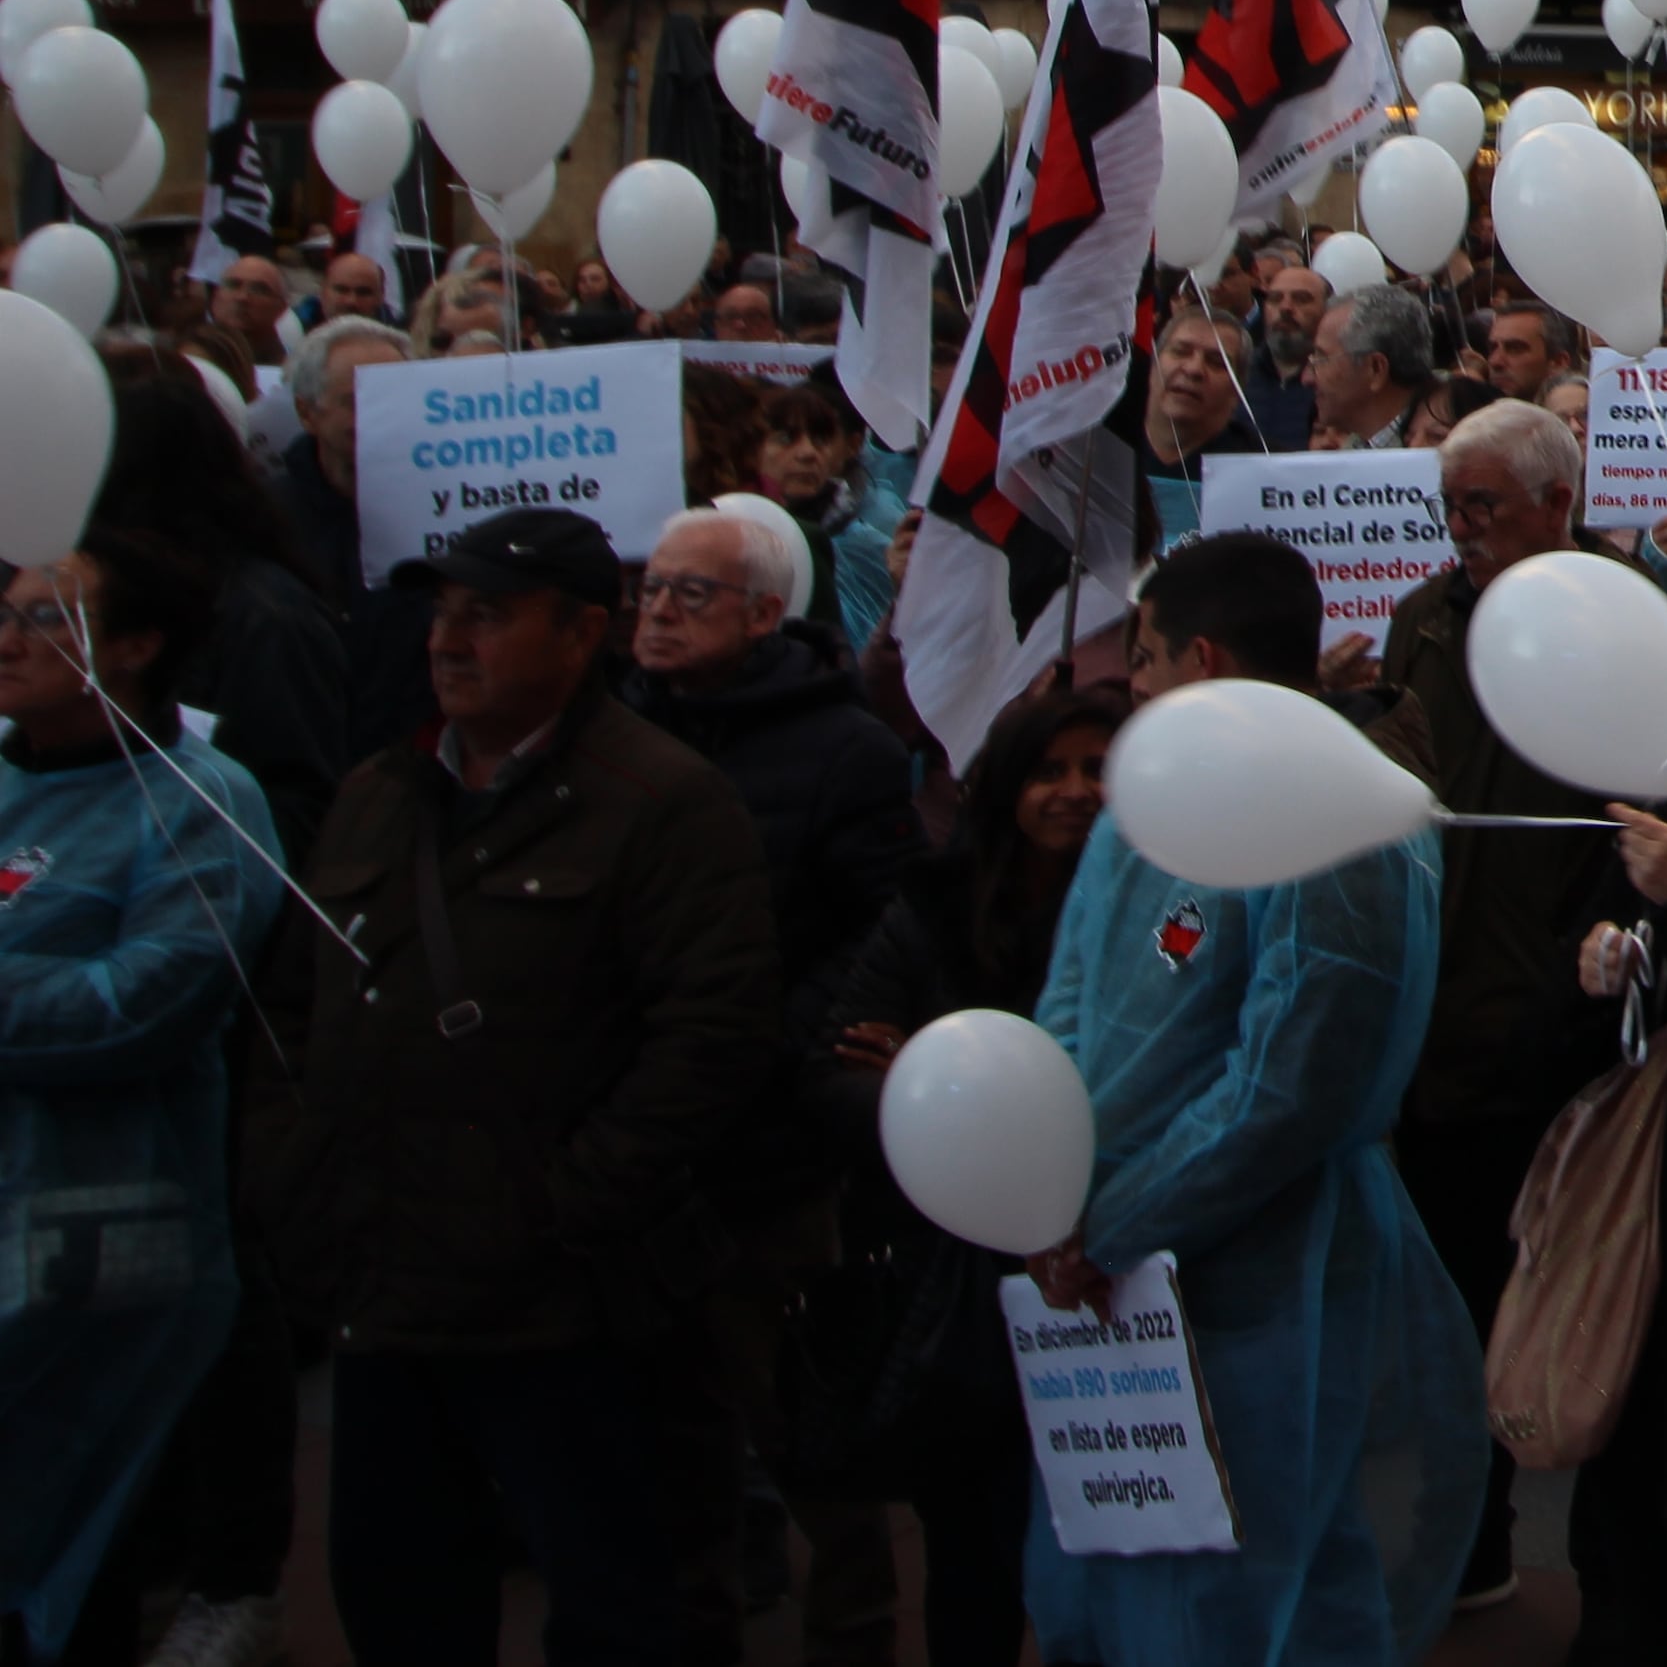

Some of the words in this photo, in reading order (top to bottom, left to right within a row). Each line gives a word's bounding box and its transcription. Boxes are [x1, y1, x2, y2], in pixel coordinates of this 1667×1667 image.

[765, 69, 931, 182] iereFuturo
[424, 376, 601, 425] Sanidad
[411, 423, 618, 470] completa
[1594, 433, 1649, 452] mera
[1602, 464, 1655, 481] tiempo
[432, 488, 451, 517] y
[461, 474, 550, 508] basta
[558, 472, 601, 503] de
[1260, 486, 1295, 509] En
[1303, 484, 1326, 506] el
[1334, 483, 1424, 505] Centro
[1592, 493, 1627, 509] días,
[1630, 494, 1649, 507] 86
[1361, 519, 1395, 543] de
[1402, 518, 1448, 542] Sor
[1324, 594, 1397, 618] eciali
[1036, 1318, 1110, 1352] diciembre
[1111, 1313, 1133, 1344] de
[1135, 1309, 1178, 1341] 2022
[1073, 1365, 1107, 1400] 990
[1110, 1361, 1183, 1396] sorianos
[1068, 1419, 1103, 1453] lista
[1104, 1417, 1128, 1451] de
[1131, 1420, 1188, 1454] espera
